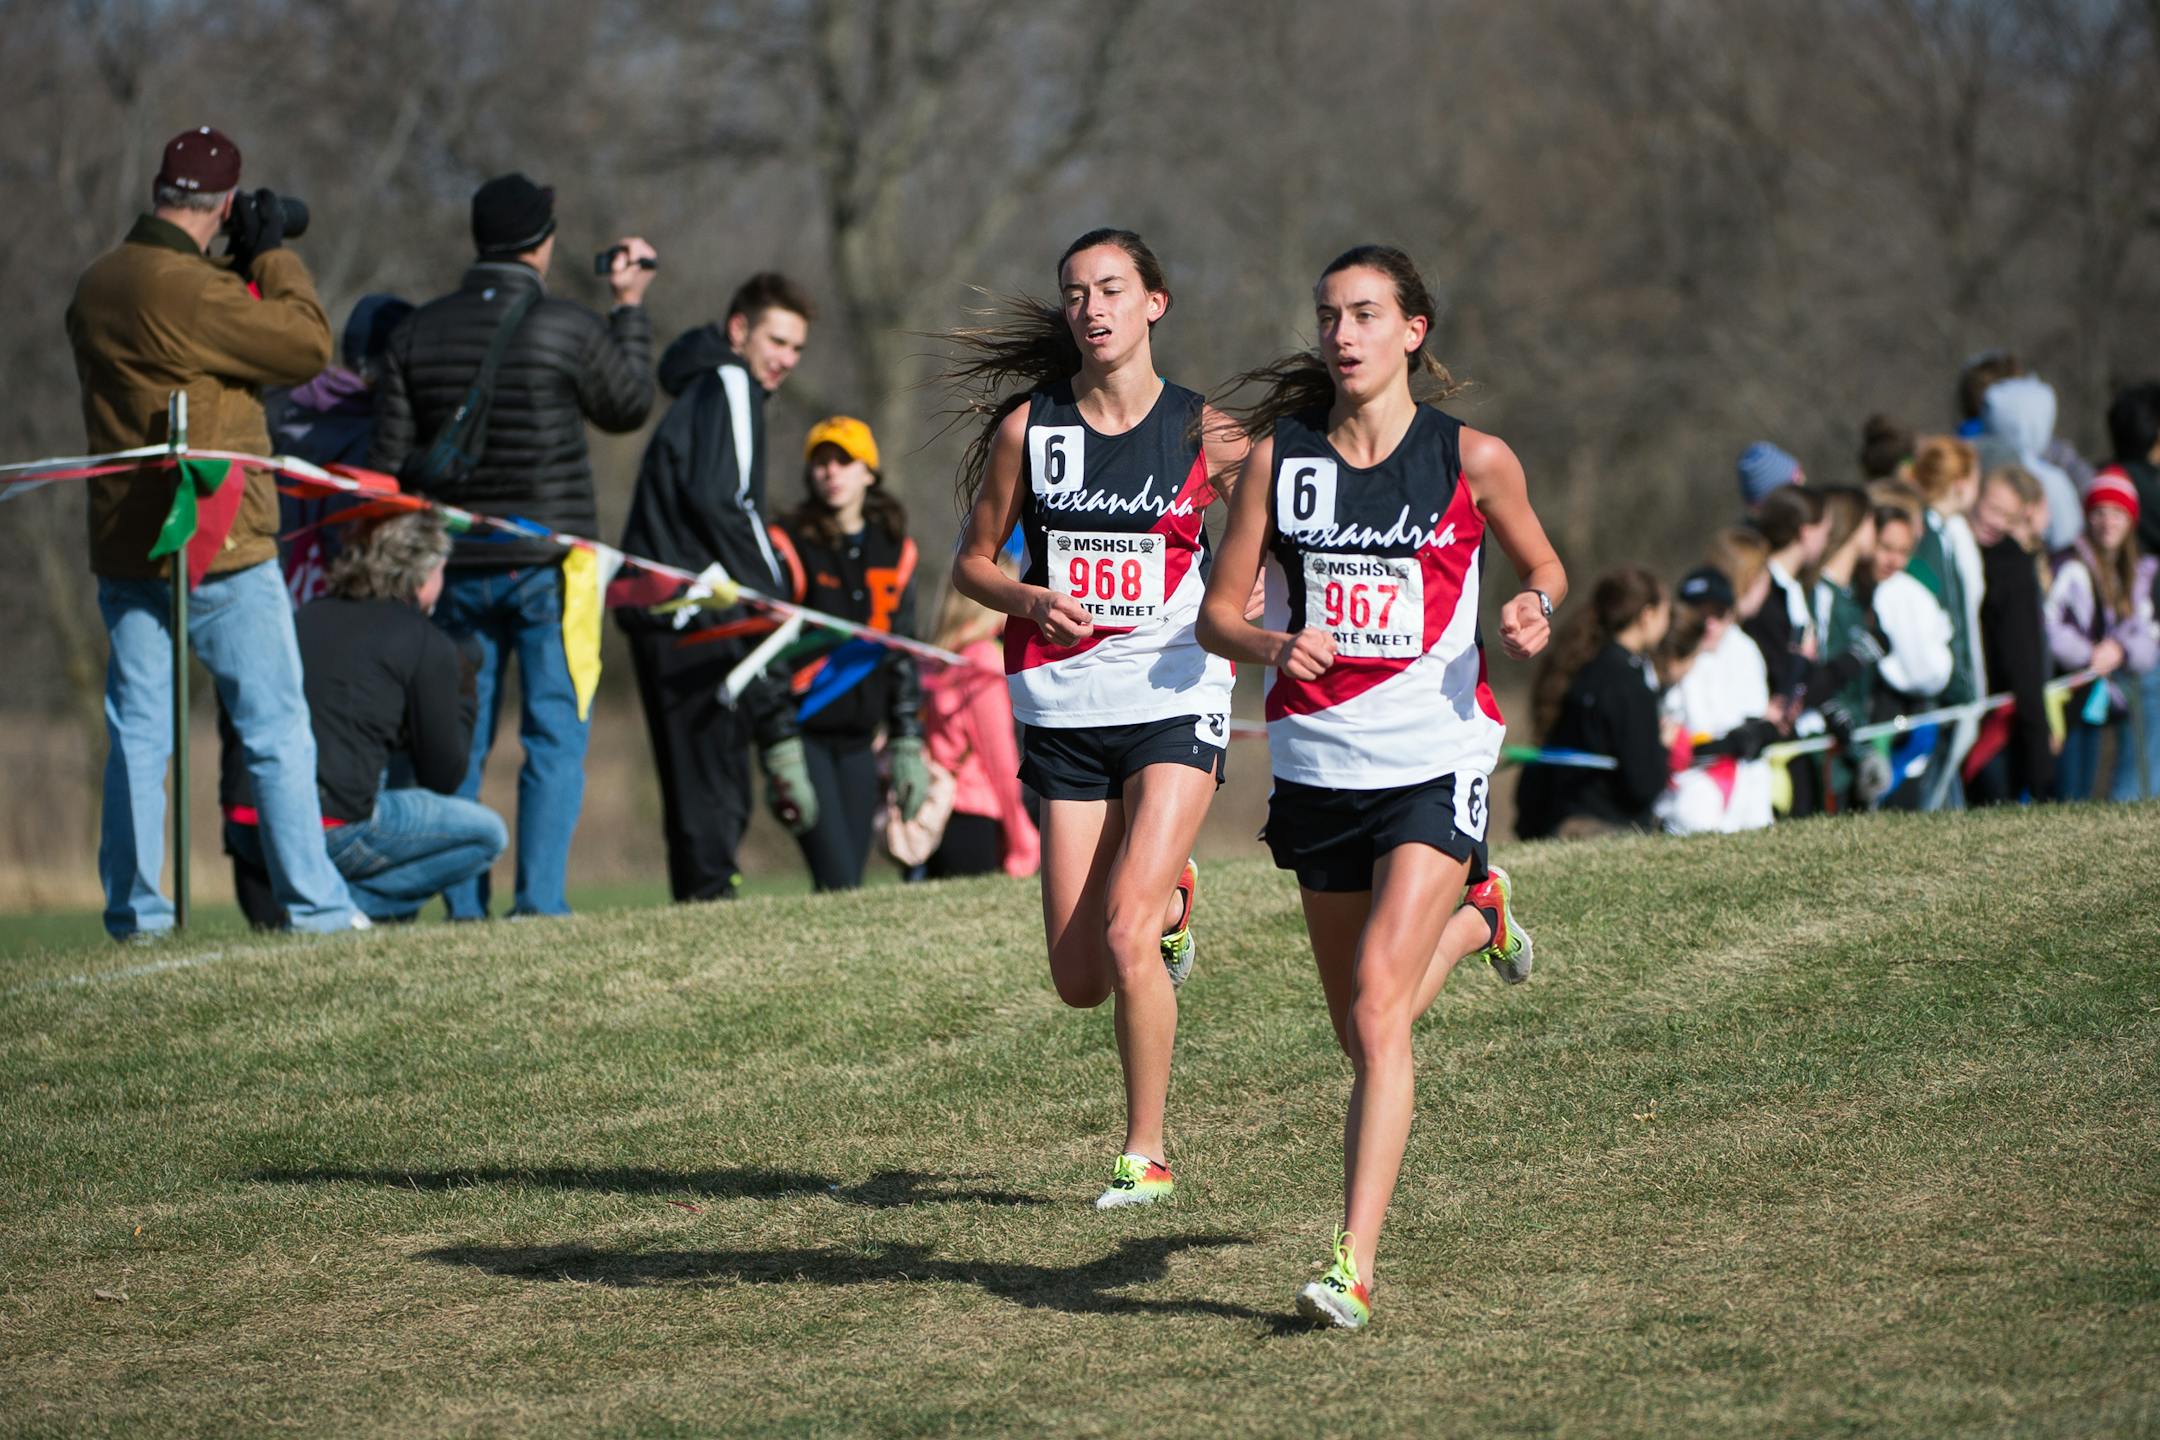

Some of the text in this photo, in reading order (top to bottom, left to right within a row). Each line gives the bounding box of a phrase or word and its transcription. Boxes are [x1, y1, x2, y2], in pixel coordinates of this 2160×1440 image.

[1044, 434, 1066, 485] 6
[1034, 475, 1193, 517] exandria
[1293, 467, 1317, 521] 6
[1074, 538, 1138, 552] MSHSL
[1281, 504, 1456, 549] exandria
[1069, 557, 1142, 601] 968
[1328, 561, 1394, 576] MSHSL
[1110, 605, 1156, 616] MEET
[1325, 582, 1400, 629] 967
[1366, 634, 1412, 646] MEET
[1468, 777, 1482, 828] 6
